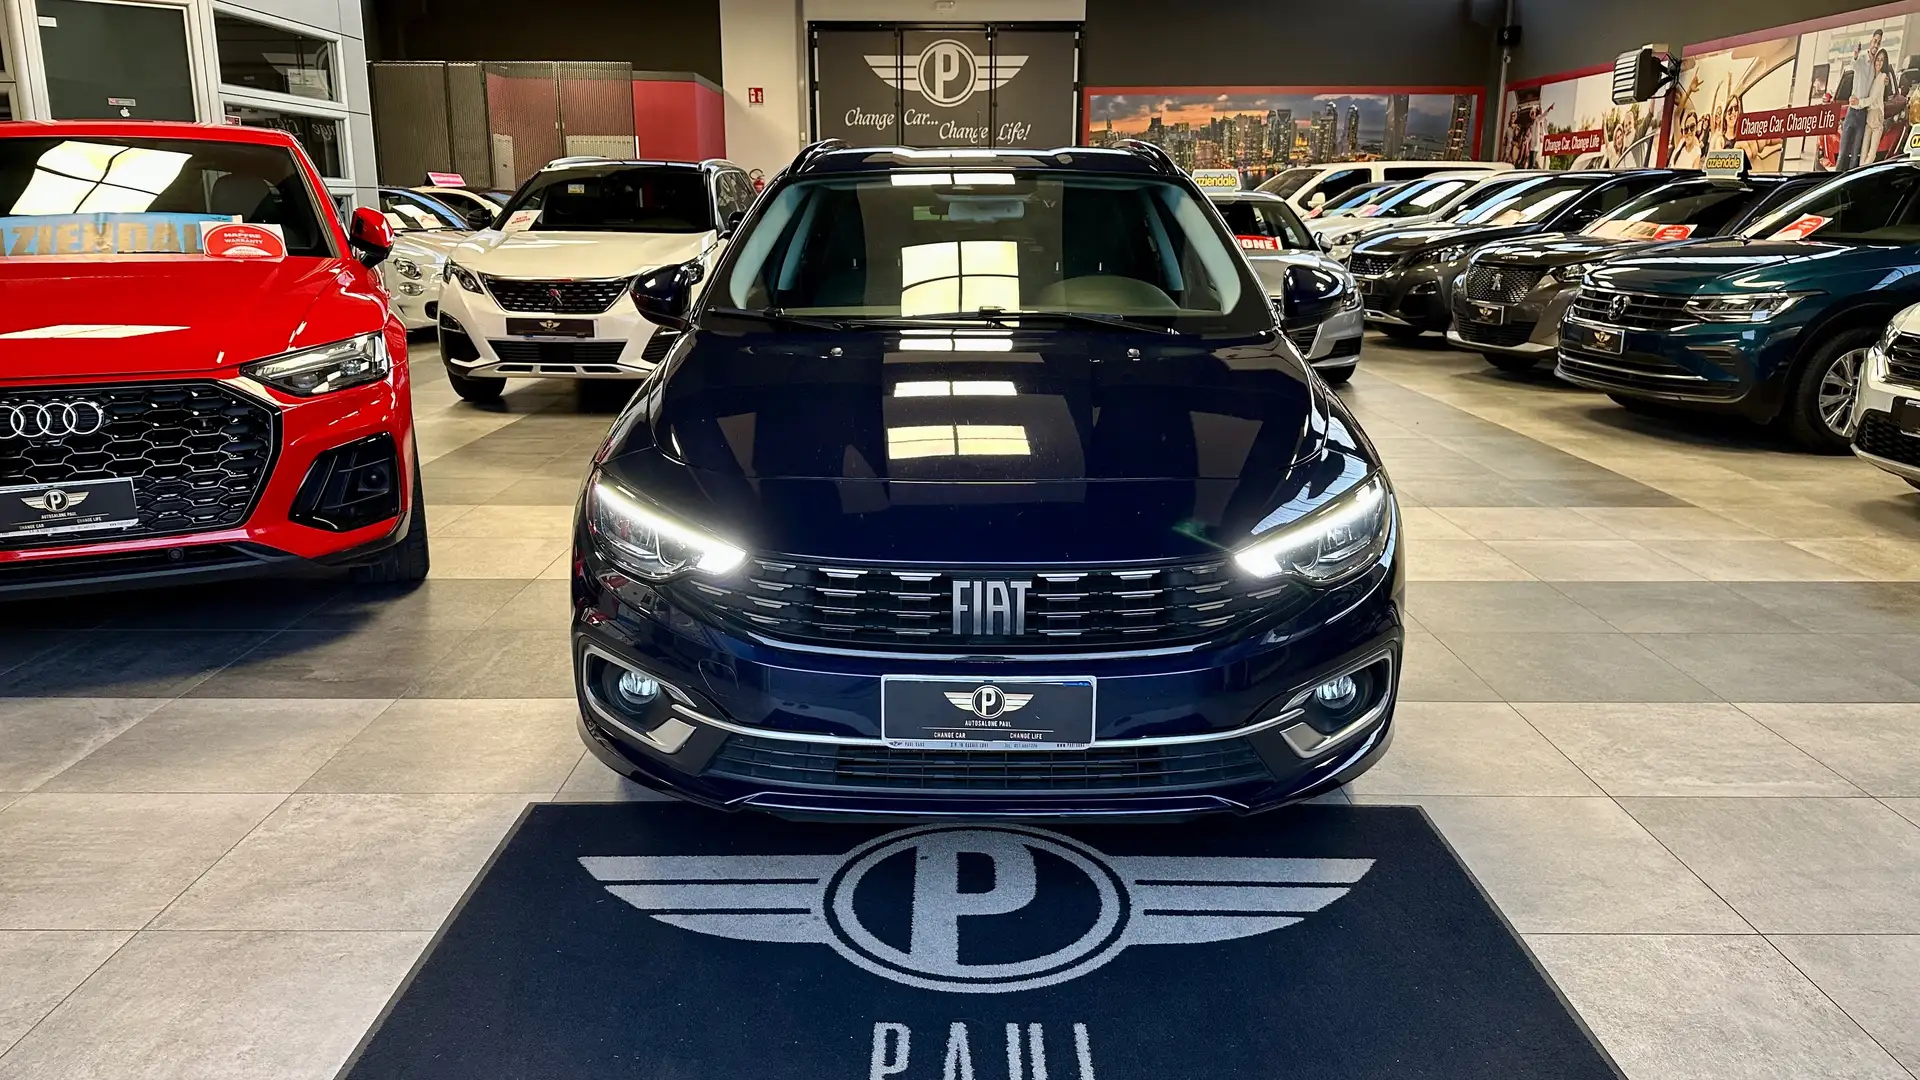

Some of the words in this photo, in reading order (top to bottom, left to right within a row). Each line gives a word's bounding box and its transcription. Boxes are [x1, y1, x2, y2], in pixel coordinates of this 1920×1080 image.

[844, 107, 895, 130] Change
[903, 108, 939, 125] Car...
[1740, 117, 1768, 137] Change
[1769, 115, 1785, 134] Car,
[1786, 113, 1817, 133] Change
[1818, 110, 1835, 129] Life
[939, 120, 988, 143] Change
[996, 122, 1032, 144] Life!
[1544, 138, 1561, 153] Change
[1571, 135, 1590, 151] Change
[1589, 134, 1600, 148] Life
[1706, 154, 1741, 169] aziendale
[1195, 174, 1237, 187] aziendale
[0, 222, 204, 255] ZIENDAL
[953, 580, 1032, 635] FIAT
[964, 719, 997, 728] AUTOSALONE
[999, 720, 1012, 728] PAUL
[933, 731, 954, 739] CHANGE
[1009, 732, 1030, 740] CHANGE
[1031, 732, 1043, 740] LIFE
